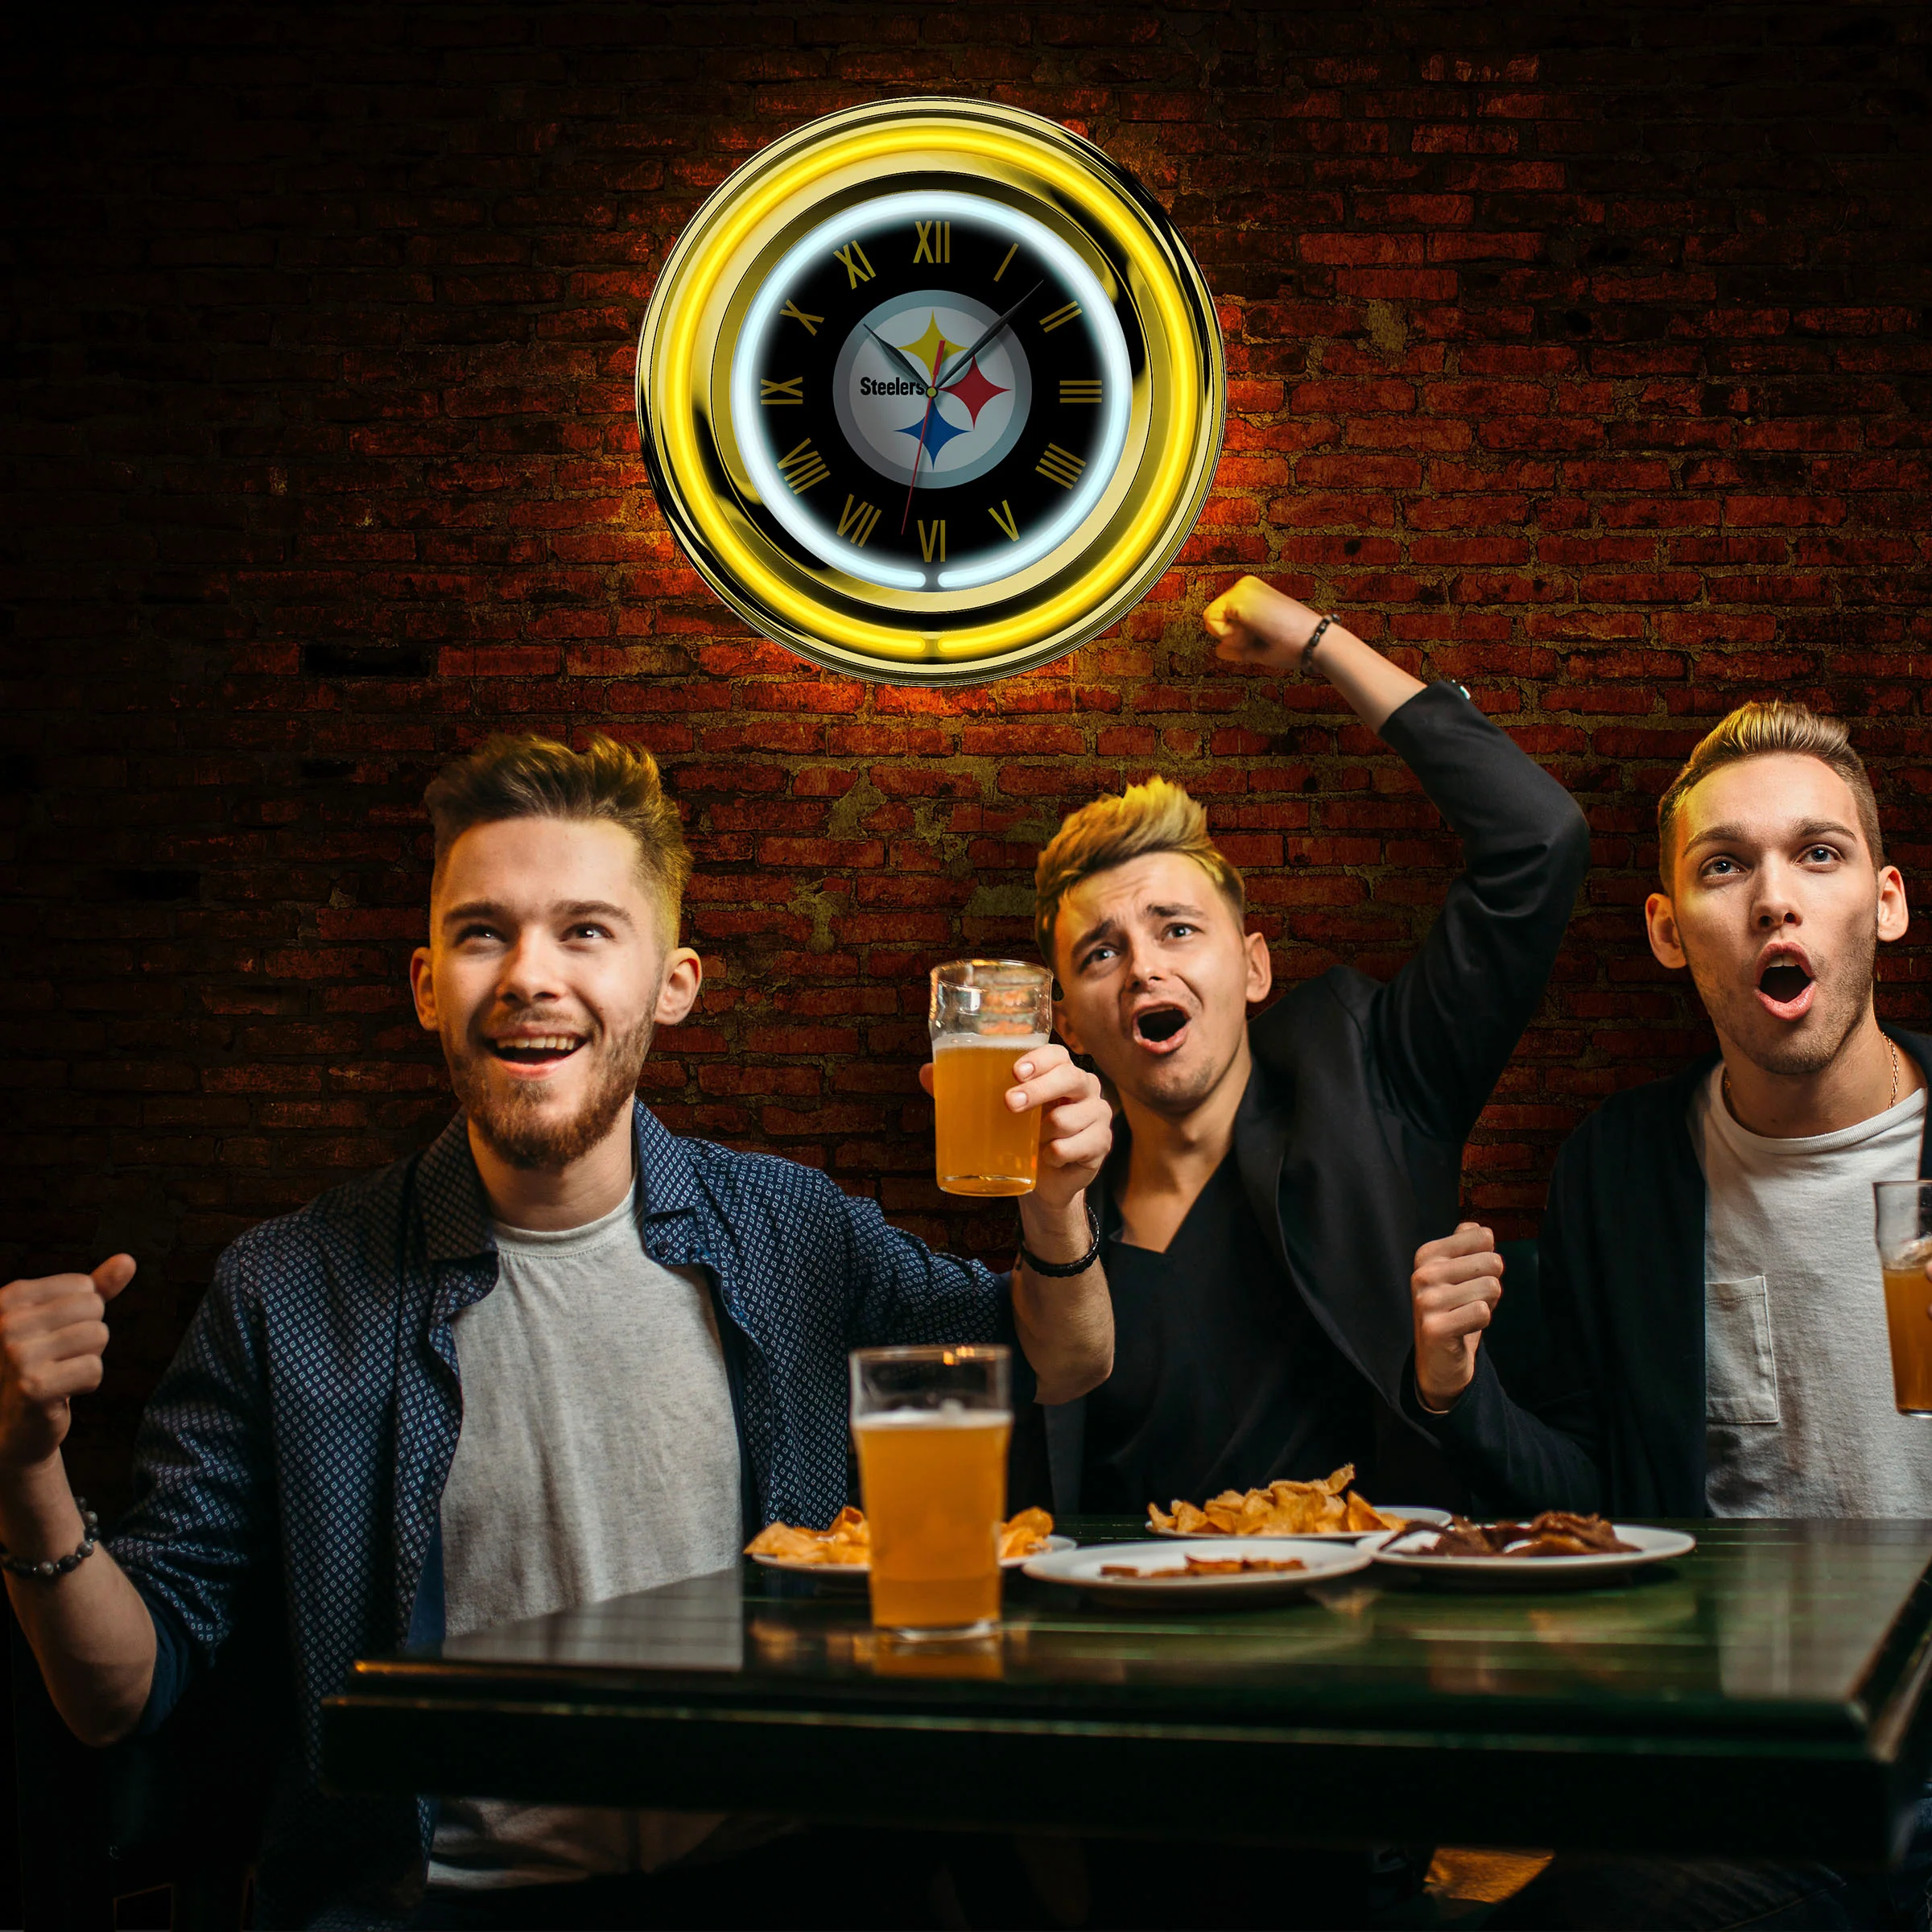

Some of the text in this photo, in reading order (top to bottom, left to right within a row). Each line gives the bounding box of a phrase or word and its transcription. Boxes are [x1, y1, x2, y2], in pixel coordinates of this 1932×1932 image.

[913, 220, 951, 264] XII
[832, 239, 877, 291] XI
[779, 299, 825, 336] X
[1038, 300, 1083, 333] II
[760, 377, 803, 405] IX
[860, 377, 925, 396] Steelers
[1059, 380, 1103, 403] III
[777, 437, 831, 495] VIII
[836, 493, 882, 548] VII
[917, 519, 947, 563] VI
[987, 499, 1021, 542] V
